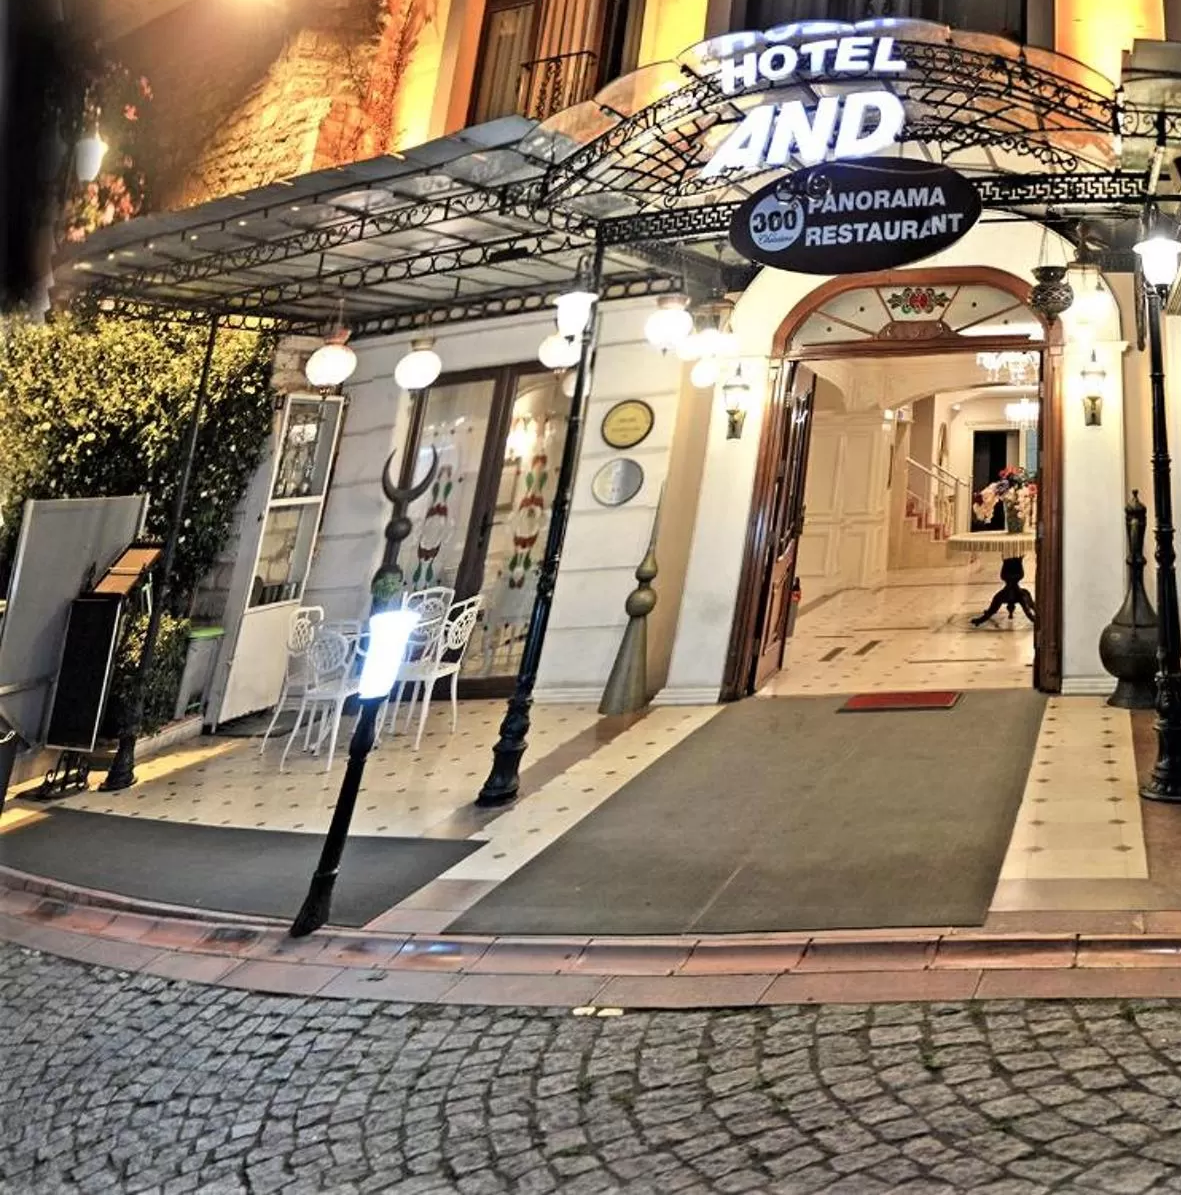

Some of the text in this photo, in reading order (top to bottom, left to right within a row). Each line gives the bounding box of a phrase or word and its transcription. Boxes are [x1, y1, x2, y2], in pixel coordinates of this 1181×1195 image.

[720, 36, 907, 95] HOTEL
[700, 90, 905, 179] AND
[807, 186, 946, 215] PANORAMA
[804, 212, 964, 247] RESTAURANT
